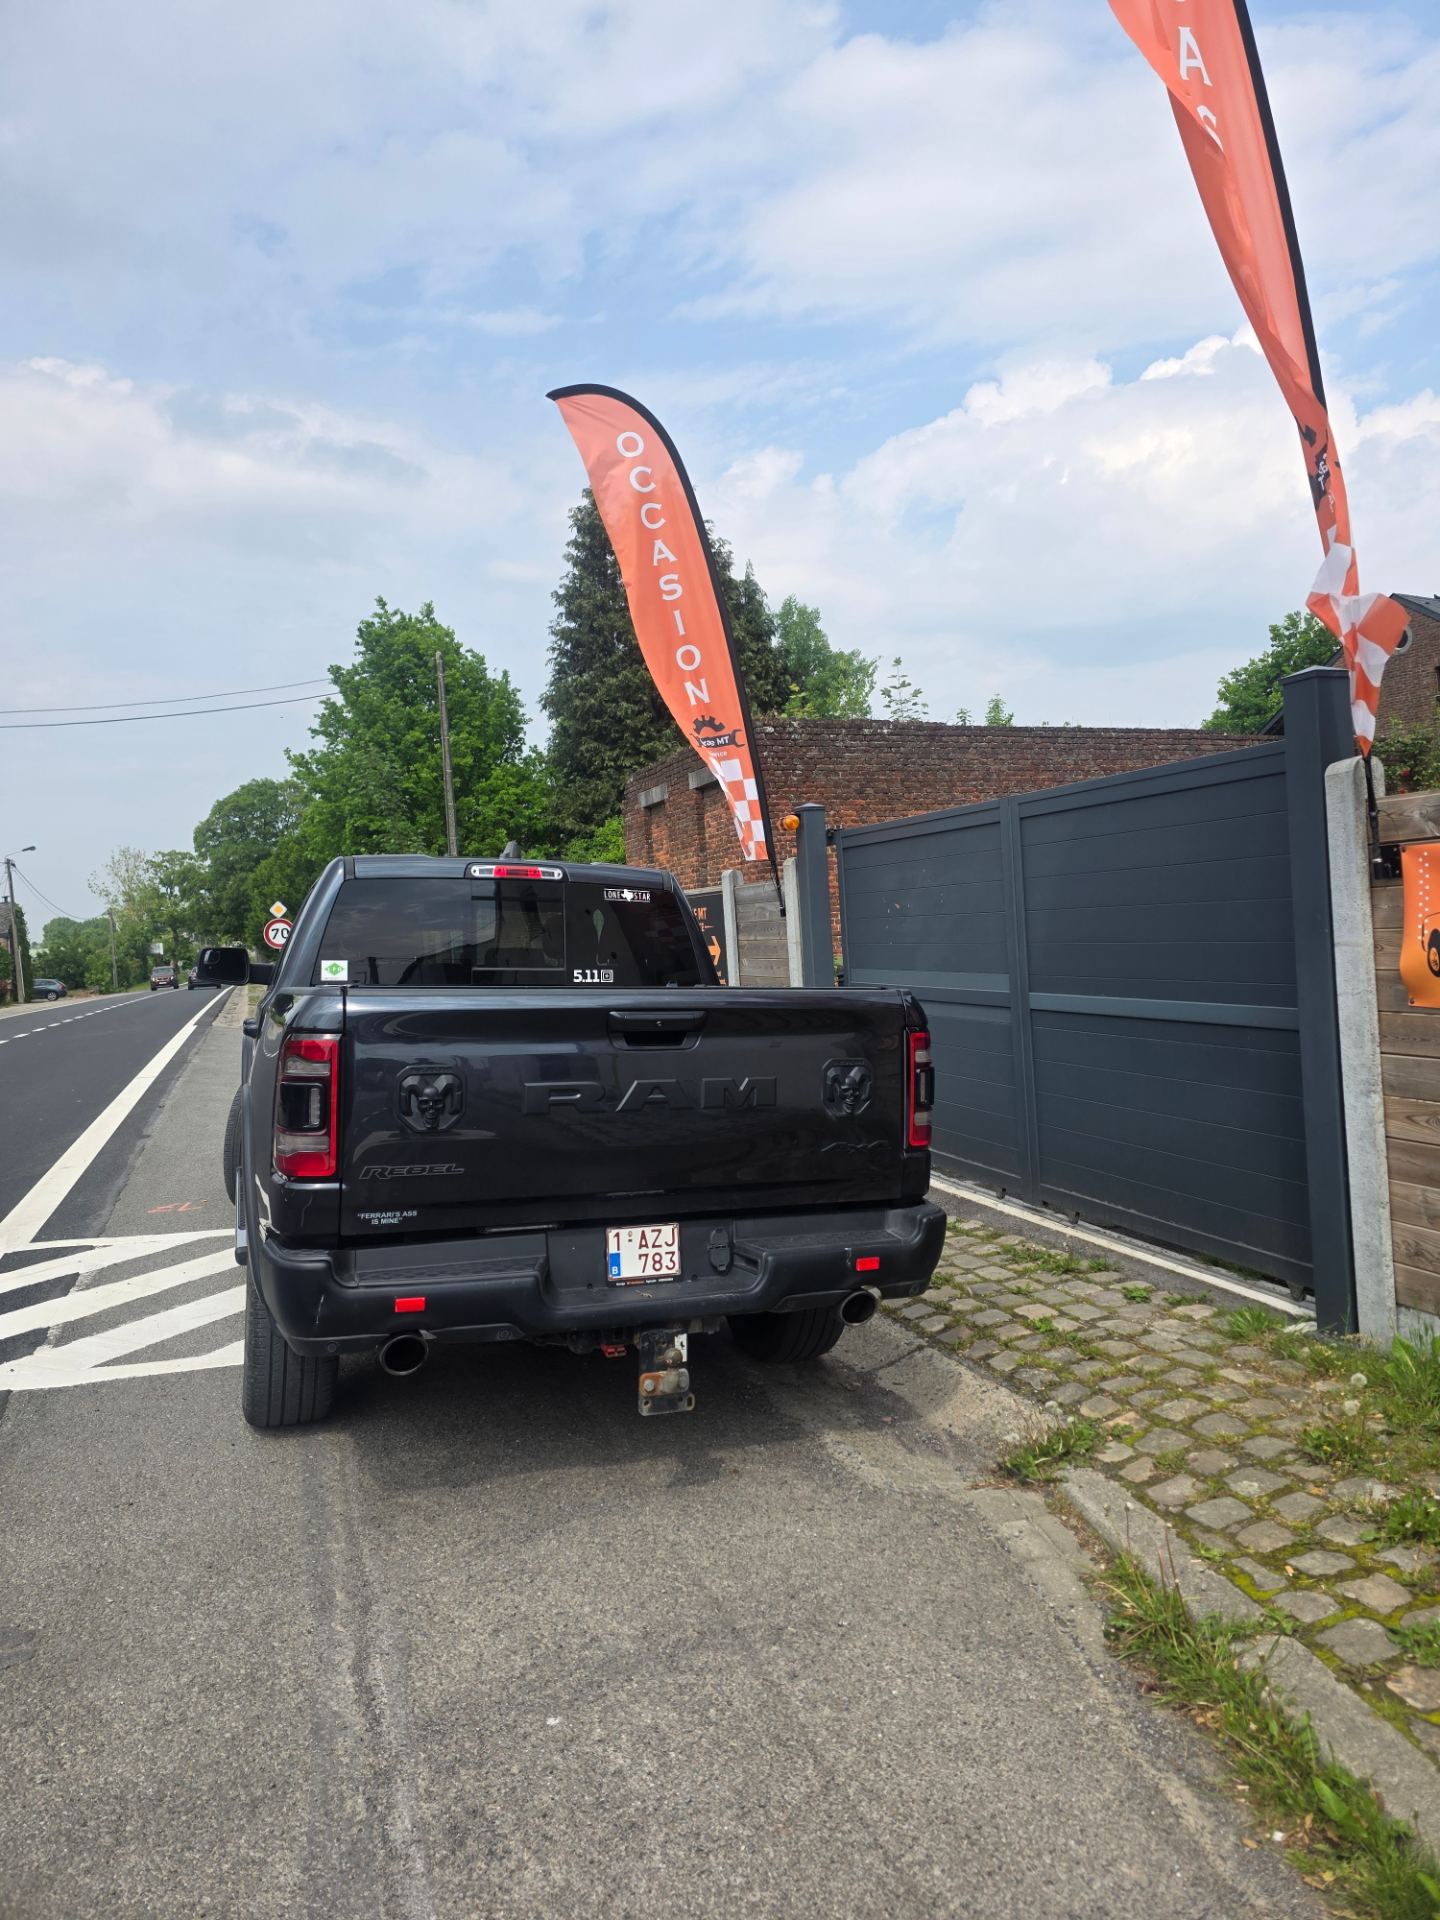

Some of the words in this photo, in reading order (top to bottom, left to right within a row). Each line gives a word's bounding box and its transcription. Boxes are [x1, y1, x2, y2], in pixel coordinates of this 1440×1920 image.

[616, 431, 711, 706] OCCASION
[603, 890, 621, 899] LONE
[633, 892, 651, 901] STAR
[271, 927, 291, 940] 70
[573, 969, 600, 983] 5.11
[523, 1076, 777, 1114] RAM
[359, 1163, 465, 1180] REBEL
[402, 1209, 418, 1217] ASS
[638, 1251, 676, 1274] 783
[611, 1266, 619, 1275] B
